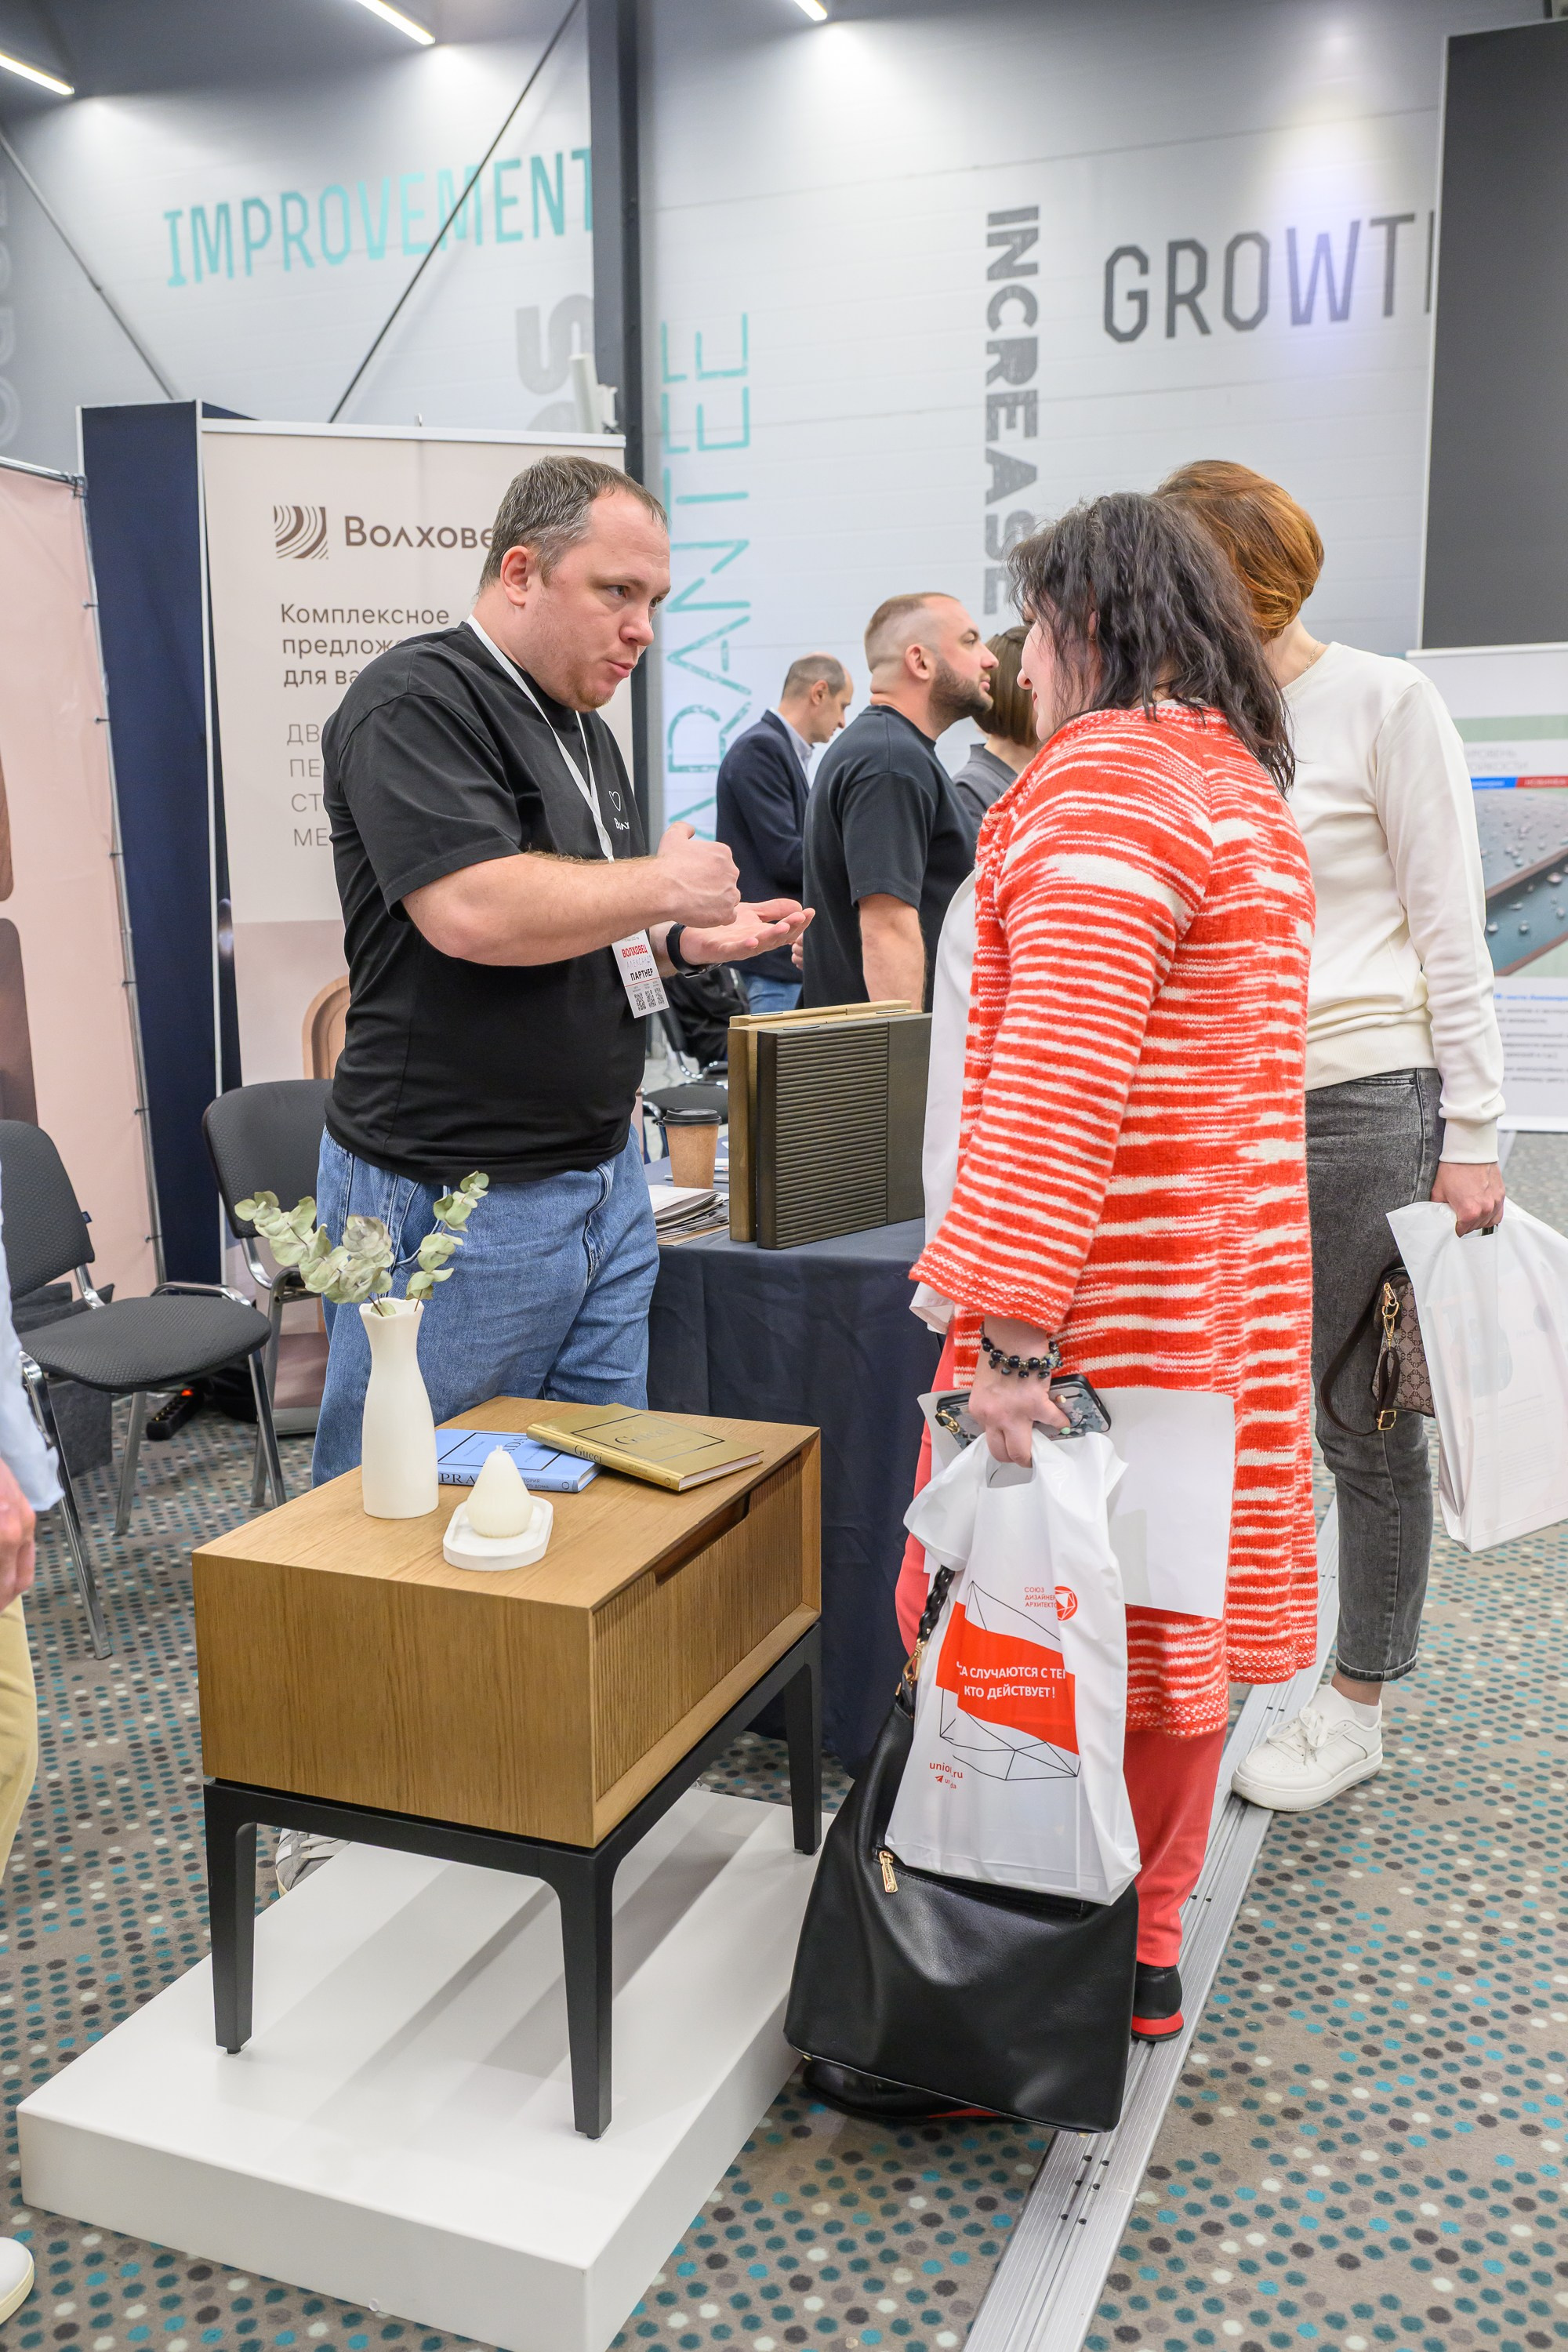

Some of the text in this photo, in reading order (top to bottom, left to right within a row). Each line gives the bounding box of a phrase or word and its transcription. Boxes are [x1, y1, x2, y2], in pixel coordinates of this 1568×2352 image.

[164, 148, 593, 288] IMPROVEMENT
[1104, 211, 1436, 343] GROWT
[281, 603, 450, 625] Комплексное
[282, 638, 404, 659] предлож
[283, 670, 327, 688] для
[287, 724, 320, 746] ДВ
[290, 758, 321, 778] ПЕ
[291, 793, 322, 812] СТ
[293, 827, 328, 847] МЕ
[621, 944, 648, 958] ВОЛХОВЕЦ
[630, 967, 653, 982] ПАРТНЕР
[574, 1444, 604, 1464] Gucci
[969, 1667, 1038, 1679] СЛУЧАЮТСЯ
[1040, 1668, 1048, 1679] С
[964, 1685, 985, 1698] КТО
